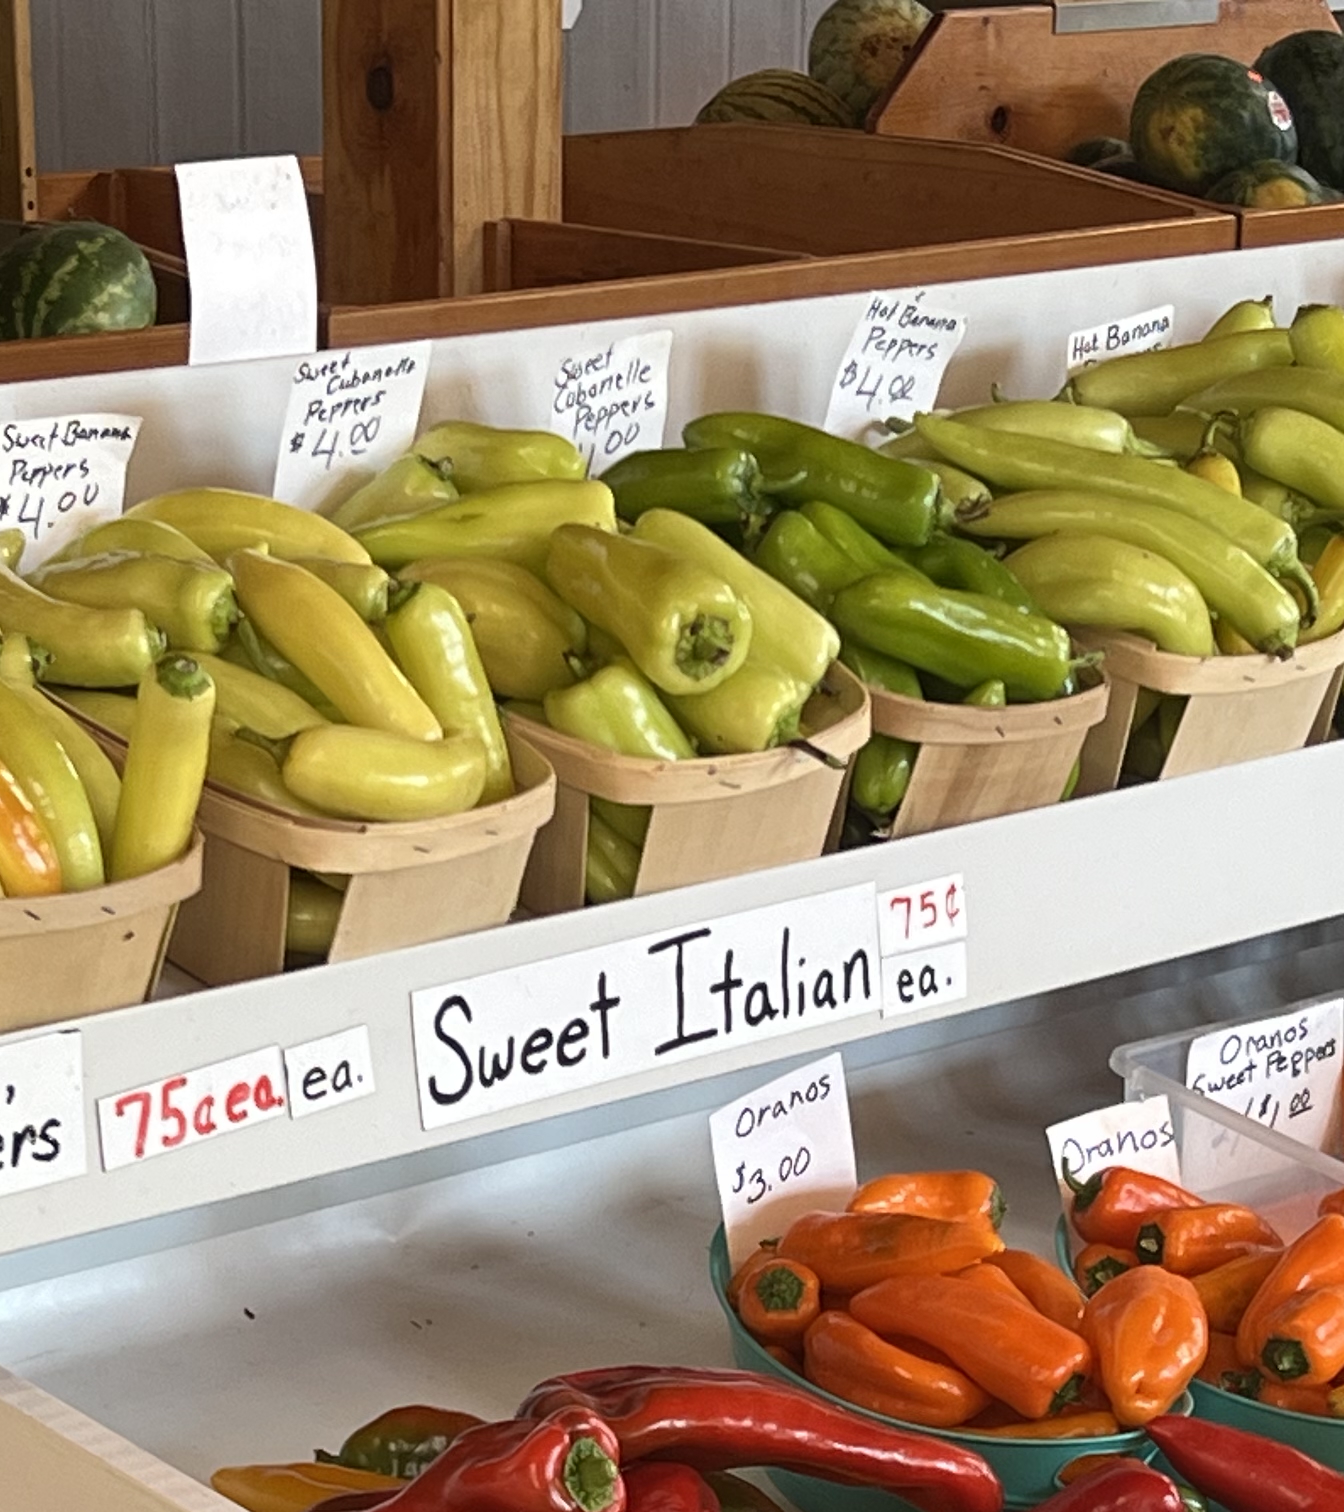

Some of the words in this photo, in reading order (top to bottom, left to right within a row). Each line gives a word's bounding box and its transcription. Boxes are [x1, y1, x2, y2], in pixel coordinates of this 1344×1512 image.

[866, 297, 900, 321] Hot
[898, 304, 957, 331] Banana
[862, 326, 938, 363] Peppers
[1072, 333, 1099, 360] Hot
[1106, 316, 1169, 351] Banana
[293, 352, 351, 384] Sweet
[303, 390, 387, 426] Peppers
[574, 391, 655, 440] Peppers
[2, 422, 59, 452] Sweet
[289, 416, 382, 470] $4.00
[9, 458, 90, 488] Peppers
[890, 882, 962, 940] 75¢
[896, 962, 952, 1004] ea.
[428, 971, 621, 1107] Sweet
[648, 926, 872, 1057] Italian
[1220, 1017, 1309, 1065] Oranos
[302, 1055, 365, 1102] ea.
[1192, 1061, 1258, 1096] Sweet
[734, 1072, 832, 1139] Oranos
[1062, 1121, 1175, 1176] Oranos
[731, 1146, 812, 1205] $3.00
